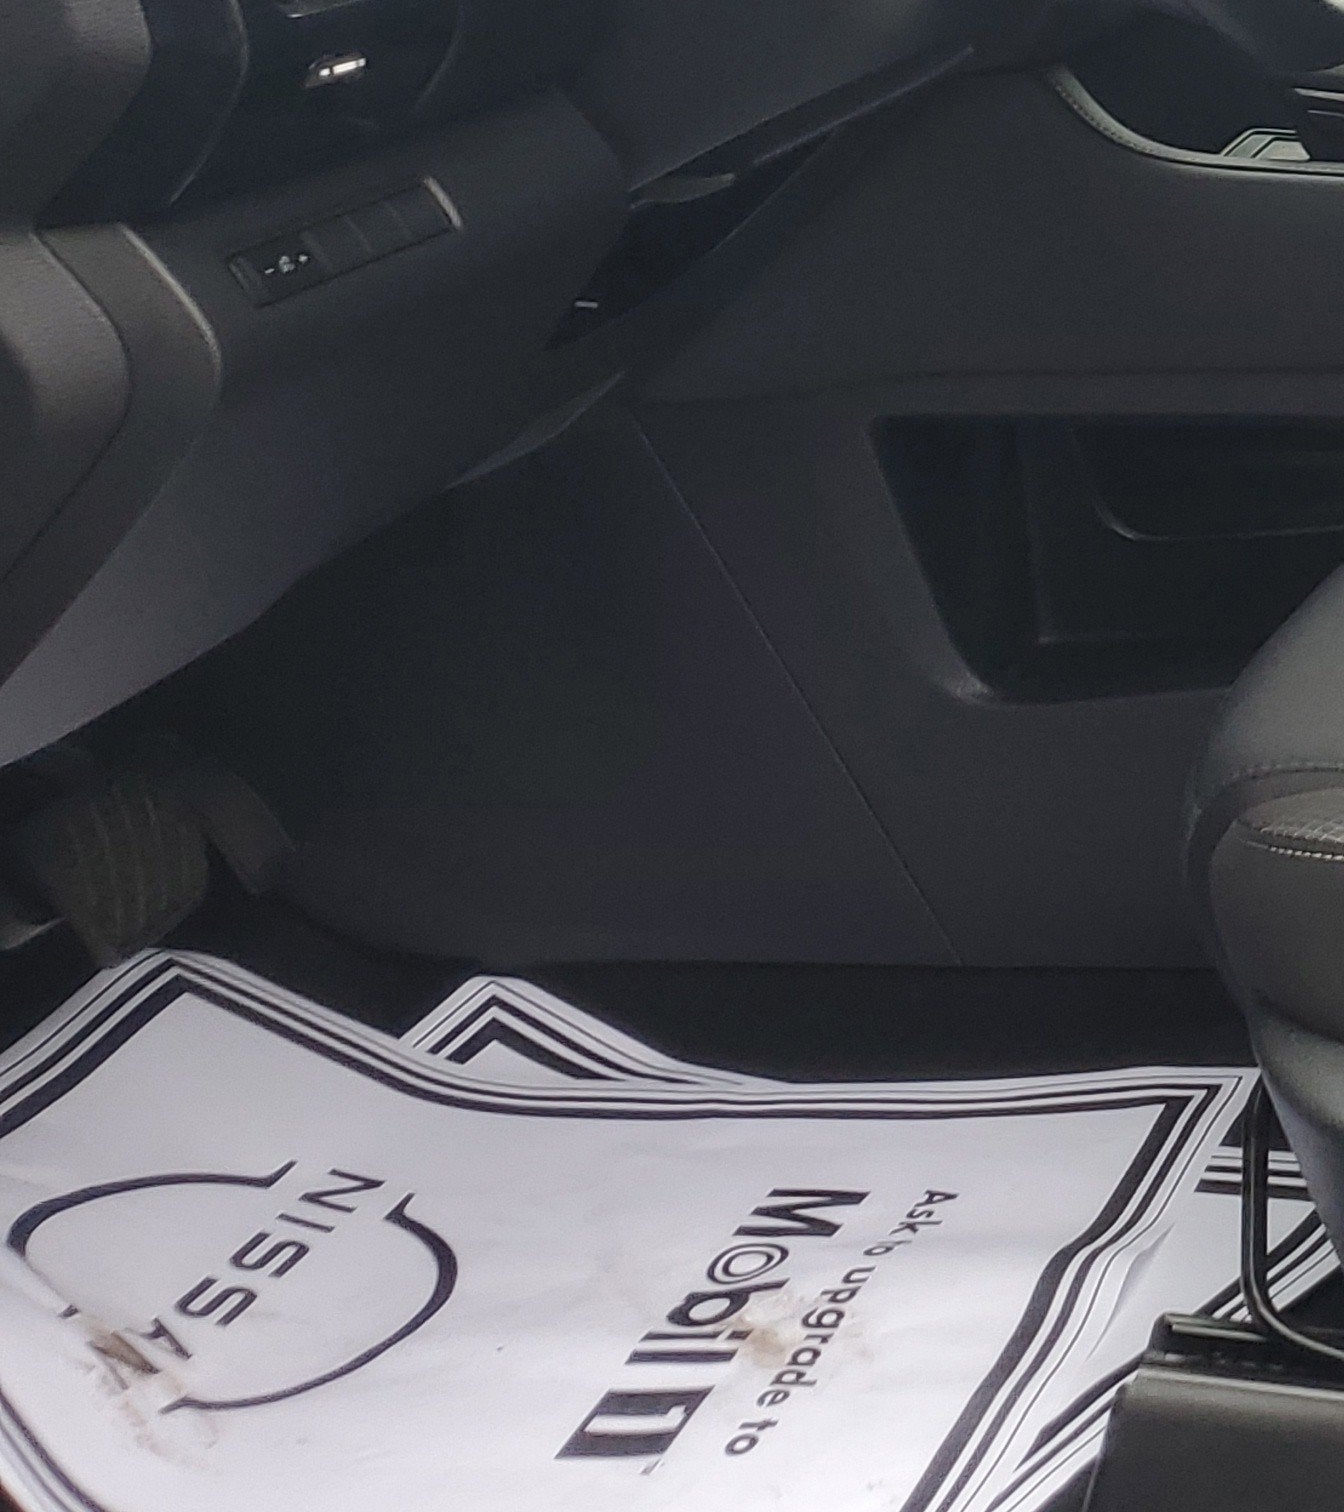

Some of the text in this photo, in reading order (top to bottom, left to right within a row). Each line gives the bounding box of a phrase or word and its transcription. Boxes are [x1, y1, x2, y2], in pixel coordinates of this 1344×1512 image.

[889, 1189, 959, 1235] Ask
[626, 1188, 871, 1365] Mobil
[756, 1265, 877, 1407] upgrade
[725, 1418, 779, 1456] to
